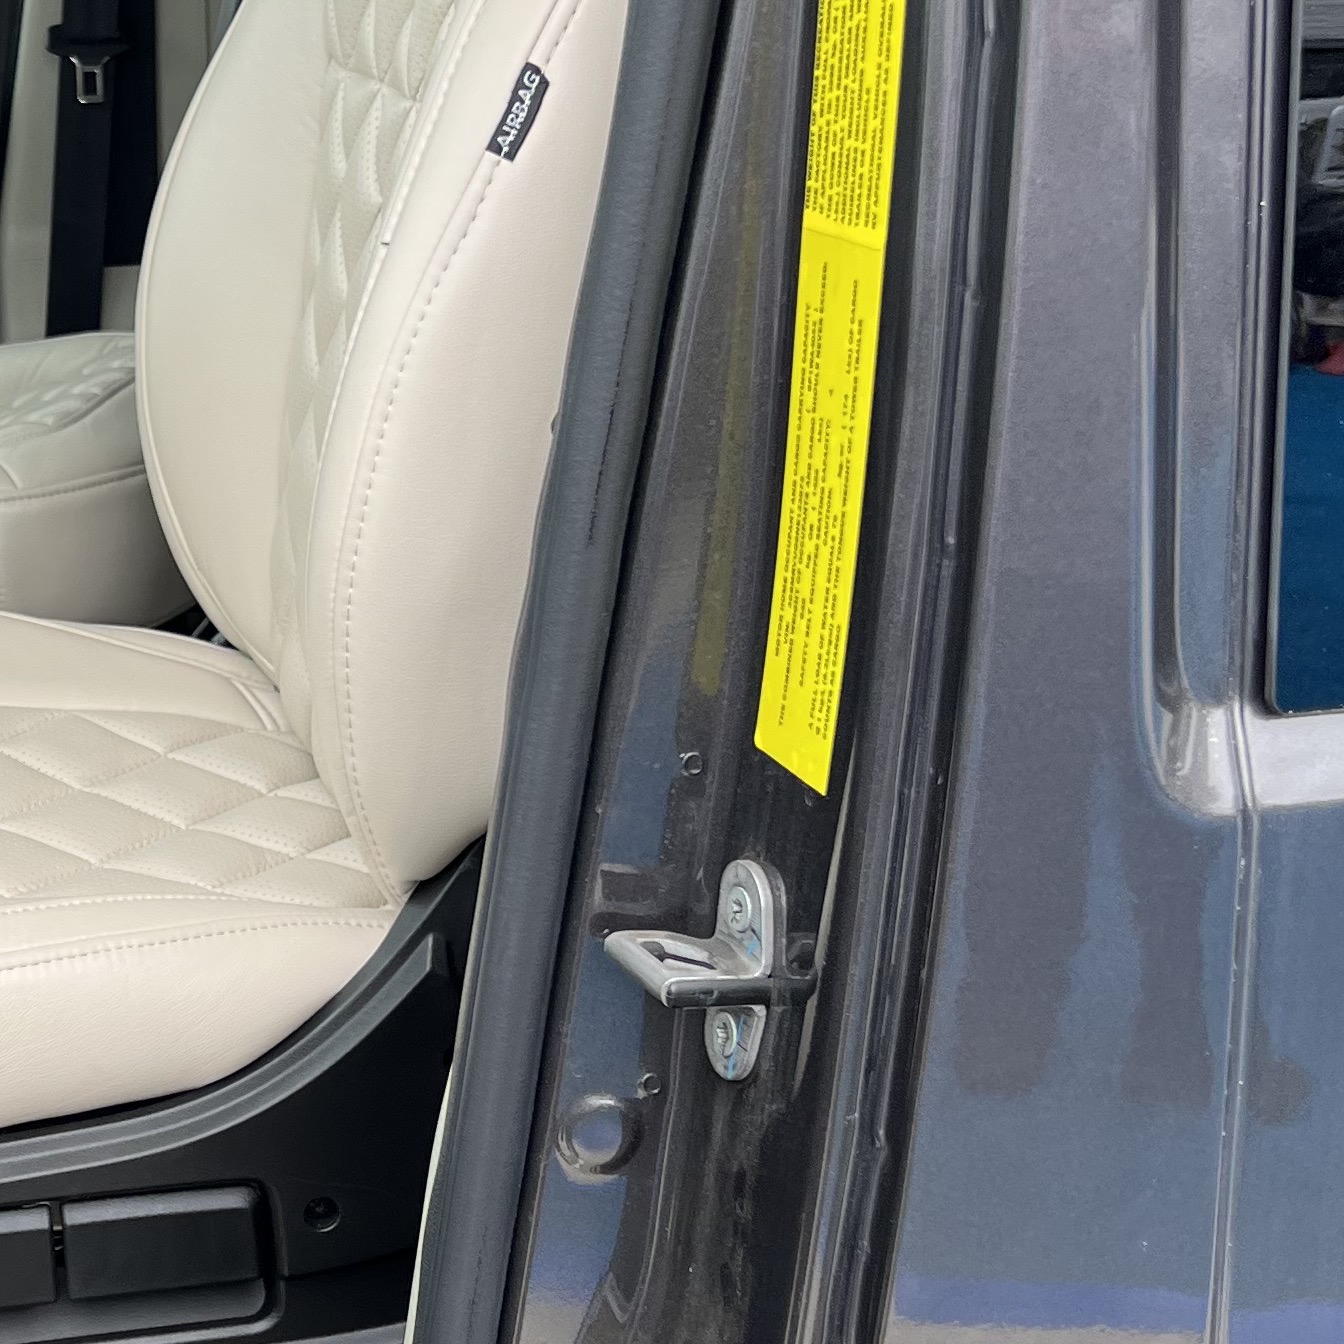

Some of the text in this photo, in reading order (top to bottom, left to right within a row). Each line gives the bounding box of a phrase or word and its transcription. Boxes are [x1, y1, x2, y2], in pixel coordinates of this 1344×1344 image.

[496, 69, 541, 154] AIRBAG
[774, 613, 783, 657] MOTOR
[783, 506, 794, 573] OCCUPANT
[792, 433, 800, 476] CARGO
[801, 302, 810, 364] CAPACITY
